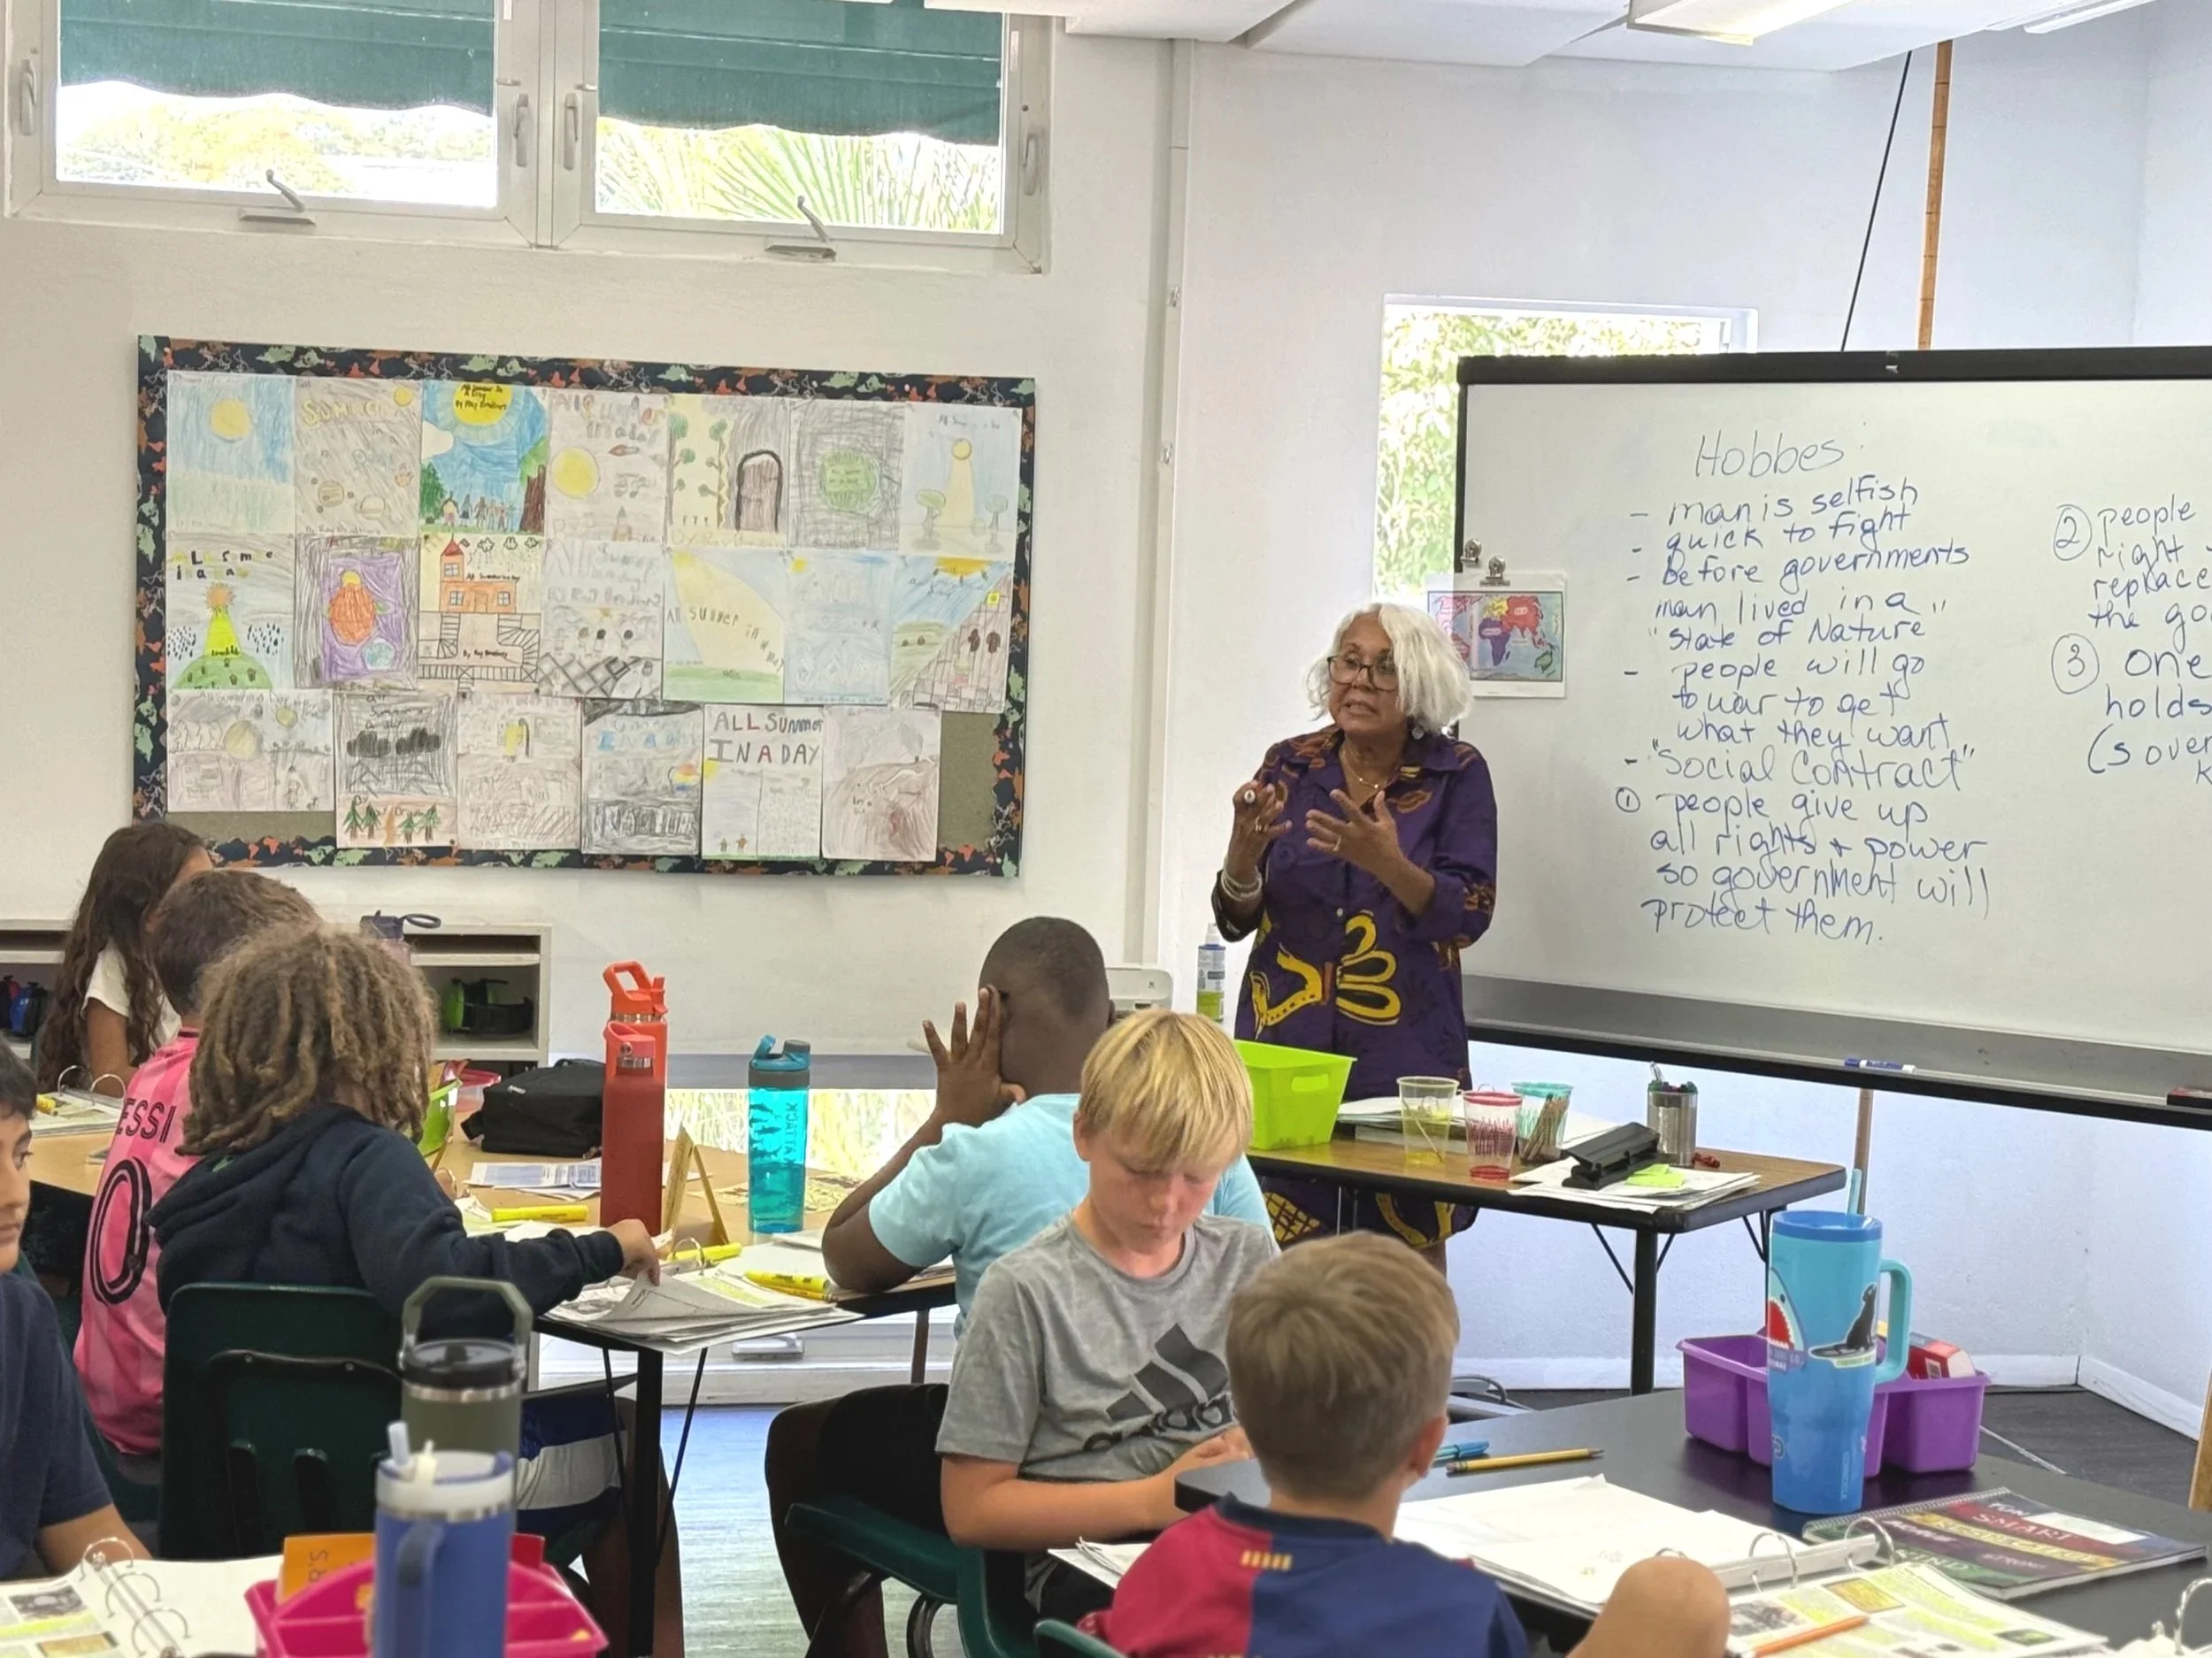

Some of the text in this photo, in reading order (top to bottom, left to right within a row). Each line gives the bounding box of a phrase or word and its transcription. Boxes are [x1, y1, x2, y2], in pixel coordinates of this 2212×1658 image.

[1669, 498, 1752, 526] man
[1764, 494, 1793, 522] is
[1811, 474, 1918, 514] selfish
[1667, 527, 1763, 557] quick
[1783, 525, 1815, 543] to
[1829, 505, 1911, 551] fight
[2098, 534, 2185, 570] right
[1780, 538, 1970, 594] governments
[2093, 566, 2211, 608] replace
[1739, 590, 1809, 625] lived
[1839, 586, 1873, 611] in
[1885, 591, 1921, 615] a
[2088, 603, 2139, 629] the
[1757, 619, 1794, 646] of
[1671, 653, 1778, 691] people
[1806, 648, 1878, 676] will
[1892, 653, 1925, 699] go
[713, 711, 760, 732] ALL
[1672, 687, 1697, 710] to
[1785, 687, 1824, 717] to
[1837, 685, 1901, 733] get
[2106, 683, 2212, 719] holds
[757, 744, 772, 764] A
[781, 743, 820, 765] DAY
[1677, 713, 1949, 761] what they want
[1792, 789, 1859, 835] give
[1878, 802, 1928, 837] up
[1651, 821, 1696, 856] all
[1716, 821, 1817, 867] rights
[1864, 837, 1988, 867] power
[1641, 890, 1778, 933] protect
[1656, 862, 1698, 887] so
[1916, 865, 1989, 921] will
[1971, 1514, 2075, 1541] SMART
